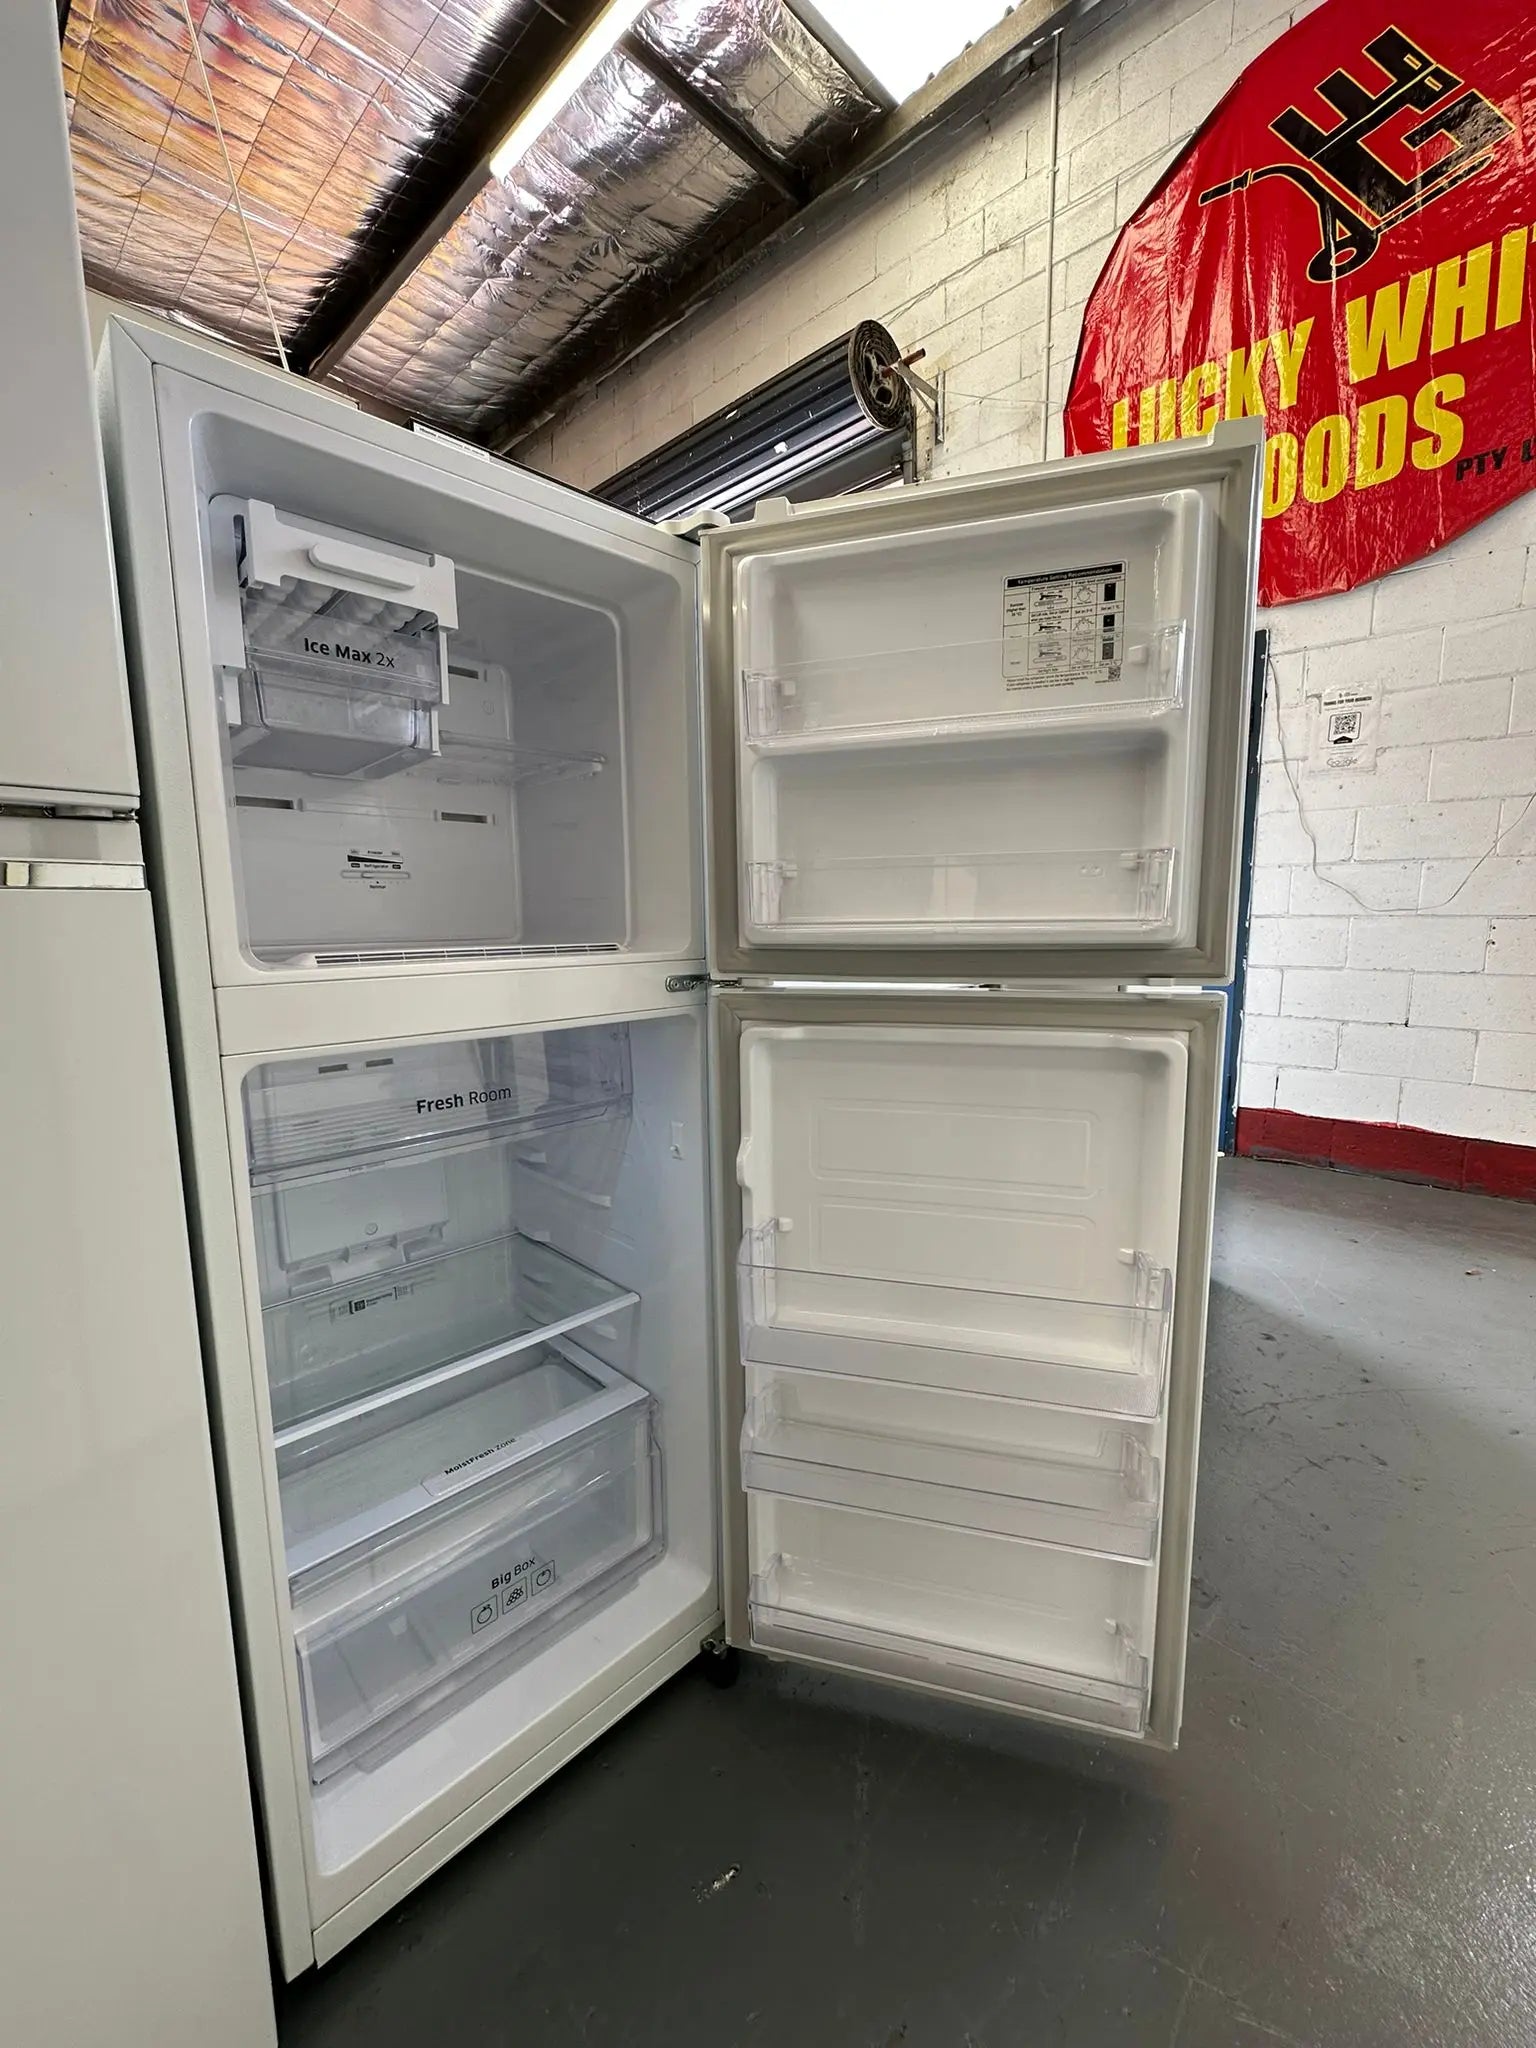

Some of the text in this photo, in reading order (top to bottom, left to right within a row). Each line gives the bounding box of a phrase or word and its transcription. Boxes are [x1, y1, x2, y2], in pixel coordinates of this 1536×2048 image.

[1347, 222, 1536, 384] WHI
[1263, 373, 1465, 519] OODS
[1456, 445, 1509, 481] PTY
[304, 637, 395, 668] Ice Max 2x
[416, 1087, 512, 1114] Fresh Room
[444, 1438, 517, 1475] MoistFresh Zone
[491, 1556, 536, 1590] Big Box
